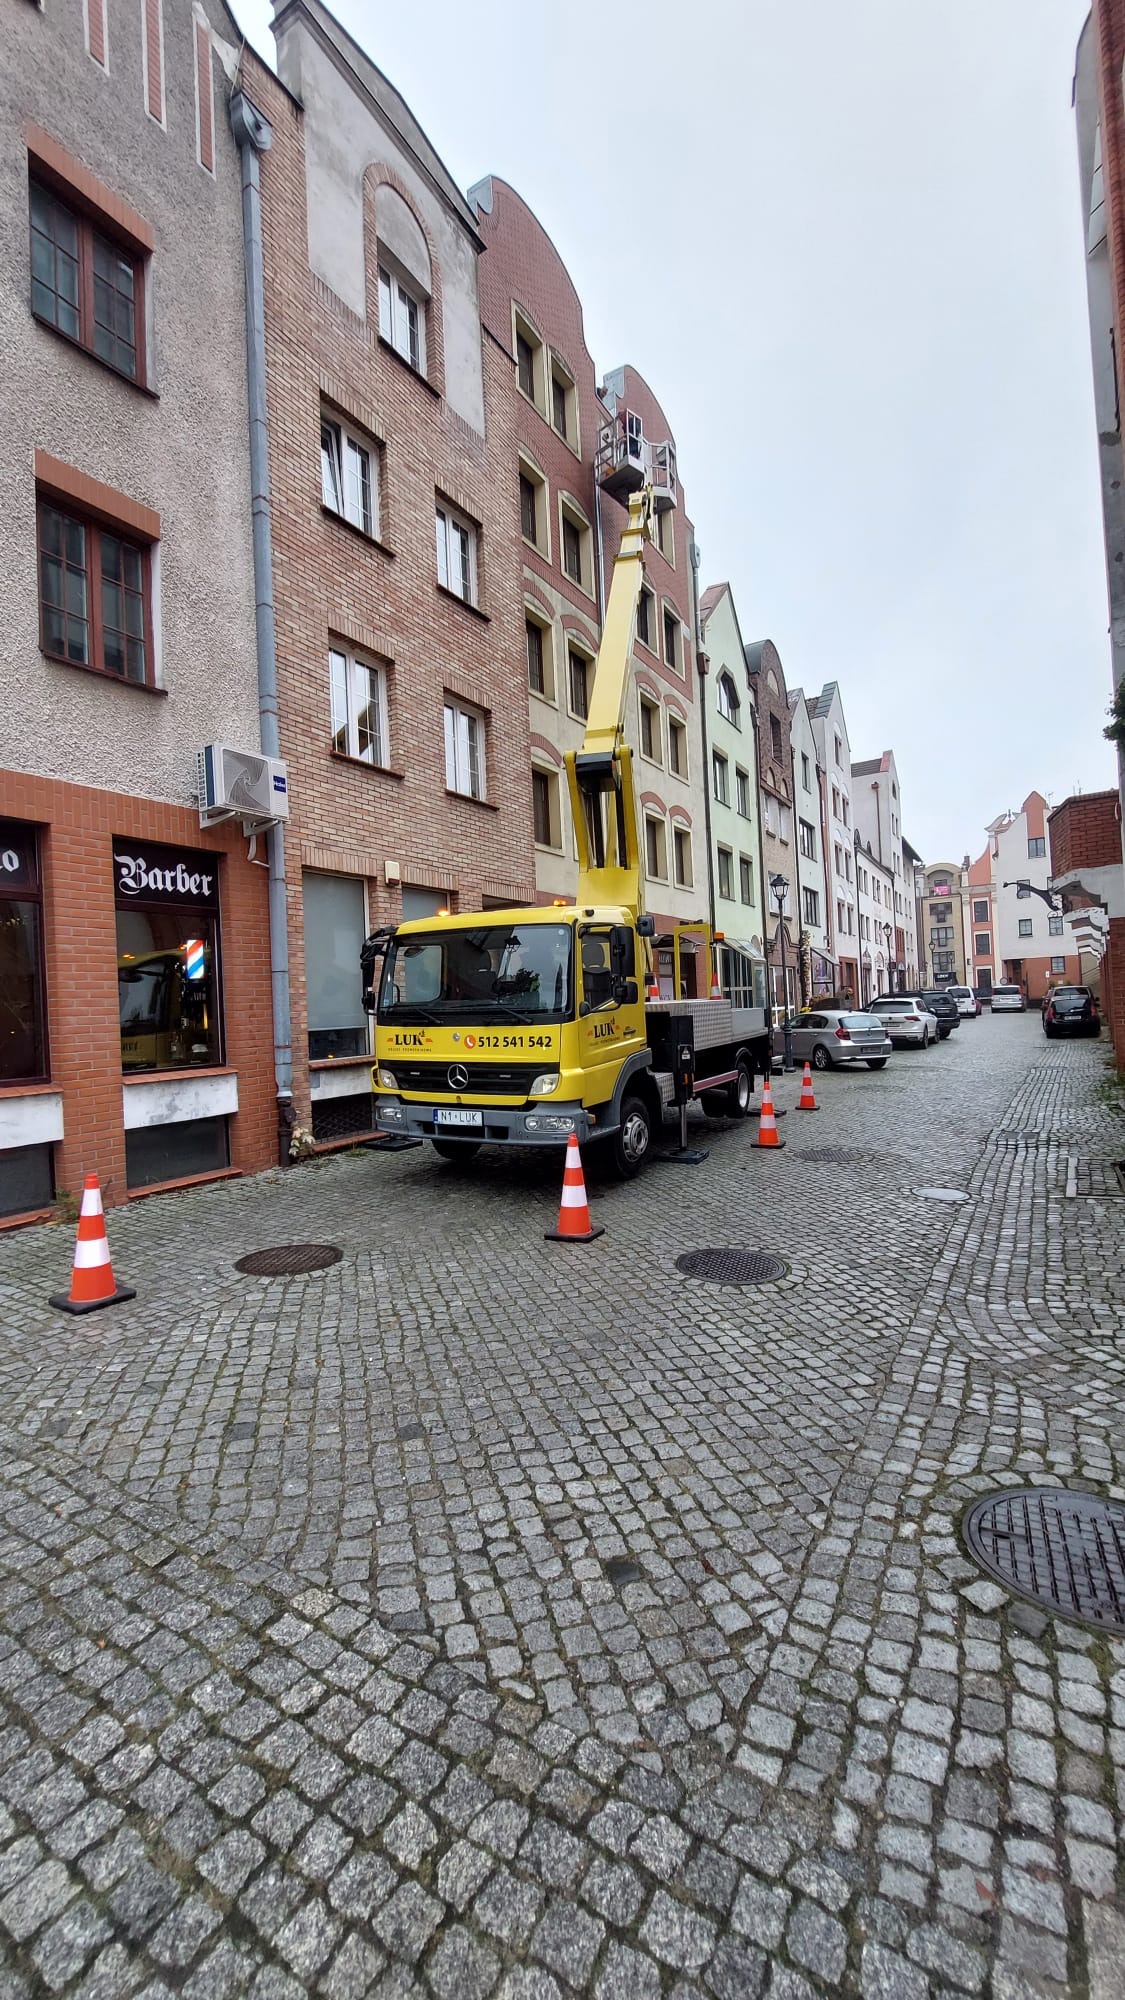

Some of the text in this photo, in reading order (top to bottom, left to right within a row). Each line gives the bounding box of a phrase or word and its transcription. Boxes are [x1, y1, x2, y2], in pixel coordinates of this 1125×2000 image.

[114, 853, 212, 896] Barber
[594, 1022, 615, 1038] LUK
[395, 1034, 423, 1046] LUK
[478, 1036, 552, 1048] 512 541 542
[441, 1111, 478, 1123] N1 LUK
